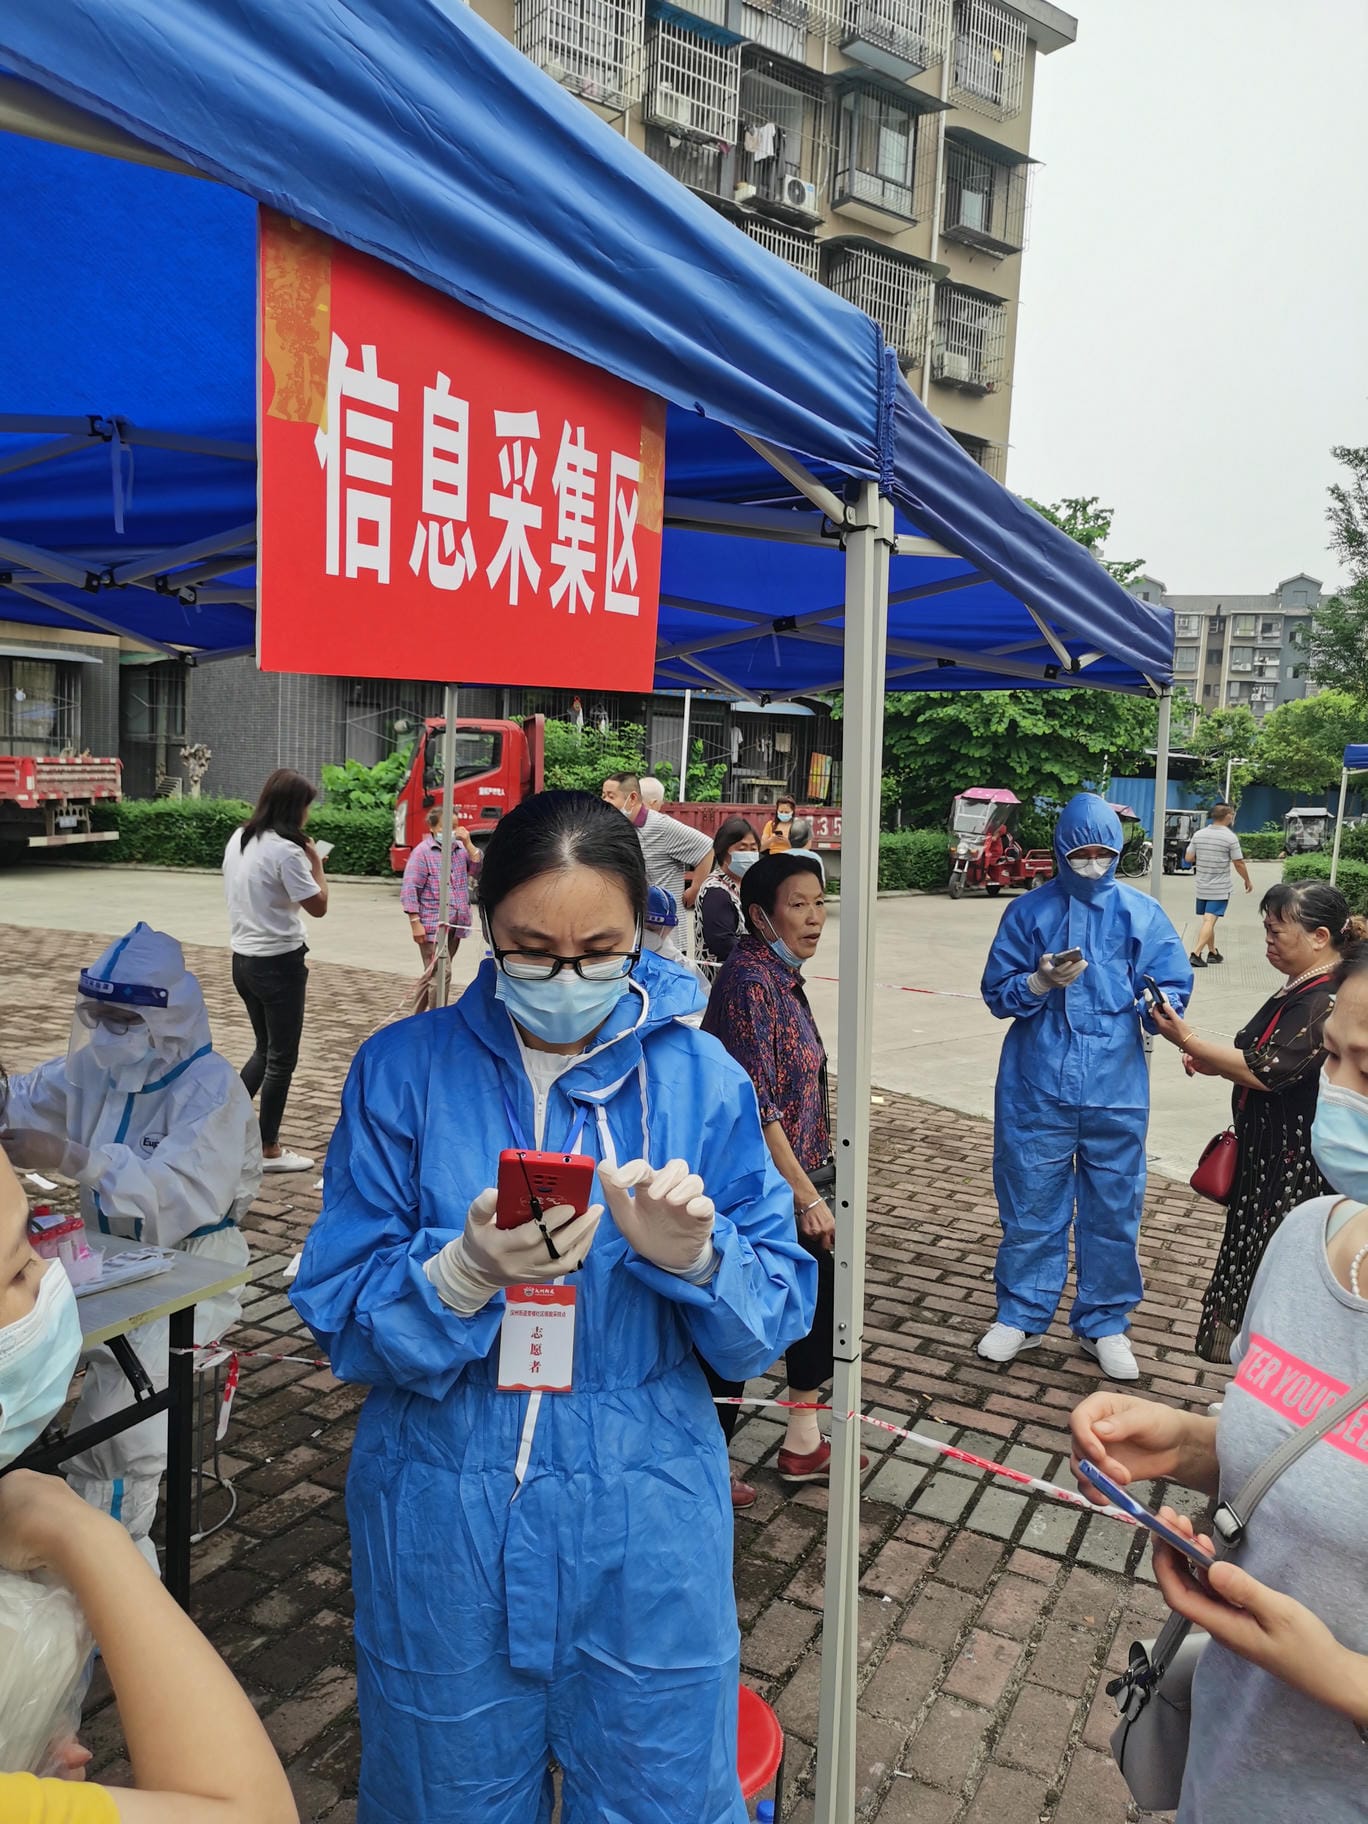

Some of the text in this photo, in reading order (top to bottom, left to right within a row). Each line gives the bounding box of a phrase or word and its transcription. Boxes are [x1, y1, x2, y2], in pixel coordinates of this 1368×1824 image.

[314, 331, 640, 616] 信息采集区
